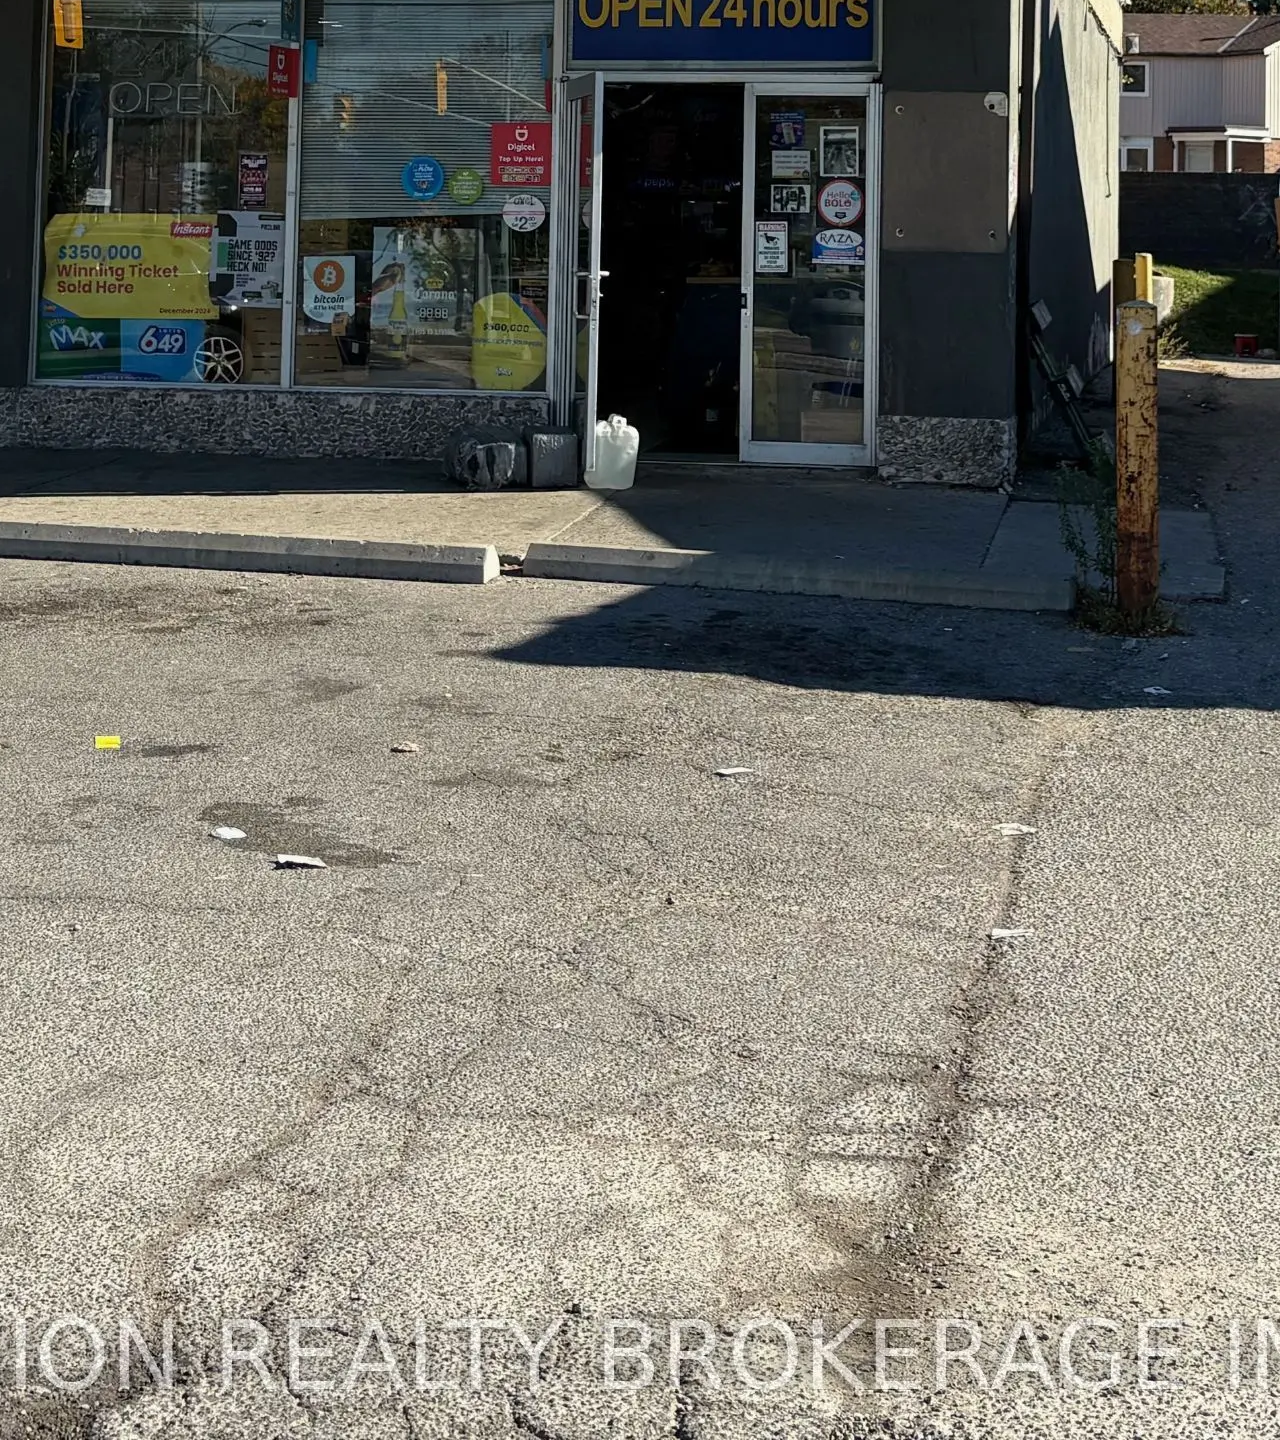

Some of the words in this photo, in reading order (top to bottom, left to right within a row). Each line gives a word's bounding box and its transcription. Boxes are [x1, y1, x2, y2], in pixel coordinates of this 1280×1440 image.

[109, 81, 236, 115] OPEN
[507, 143, 535, 152] Digicel
[173, 223, 211, 236] Instant
[228, 239, 252, 250] SAME
[254, 240, 278, 251] ODDS
[820, 233, 854, 245] RAZA
[58, 245, 142, 262] $350,000
[227, 250, 253, 261] SINCE
[57, 263, 125, 281] Winning
[129, 263, 179, 278] Ticket
[226, 261, 250, 272] HECK
[252, 262, 267, 273] NO!
[57, 280, 92, 294] Sold
[96, 280, 134, 294] Here
[313, 295, 345, 303] bitcoin
[49, 325, 105, 351] MAX
[140, 326, 184, 353] 649
